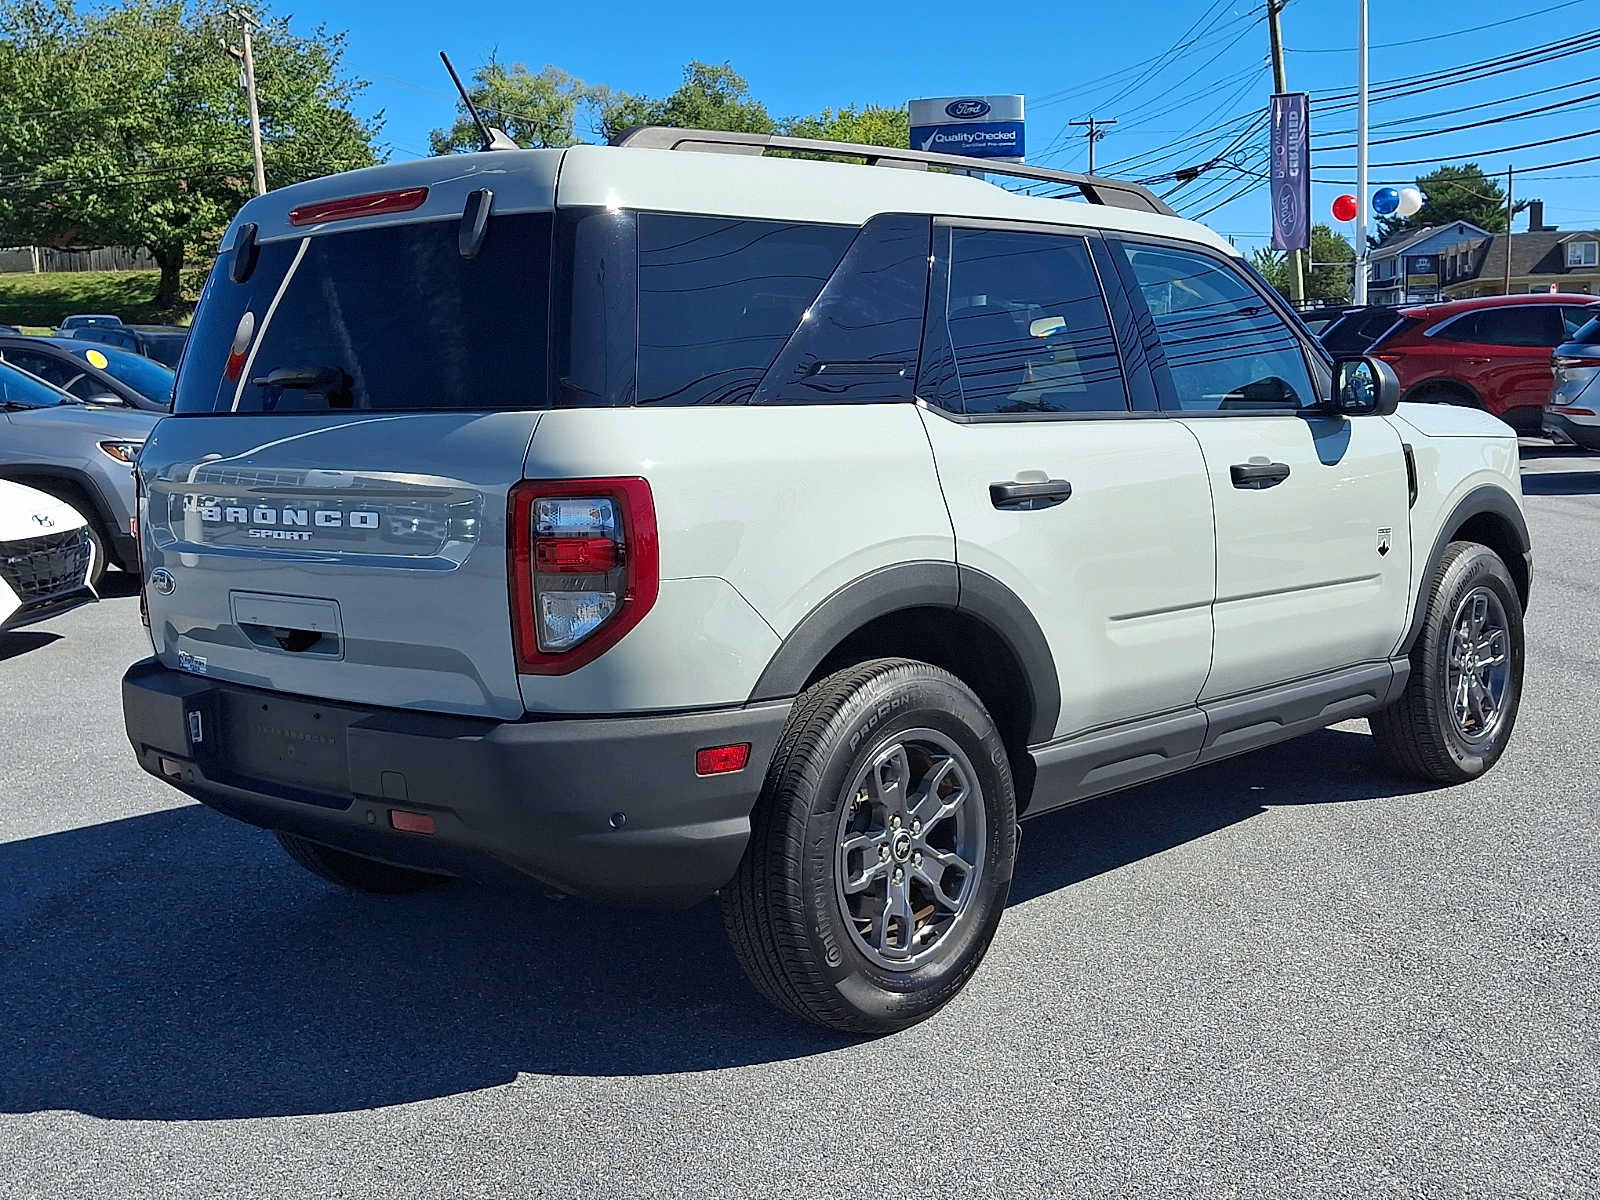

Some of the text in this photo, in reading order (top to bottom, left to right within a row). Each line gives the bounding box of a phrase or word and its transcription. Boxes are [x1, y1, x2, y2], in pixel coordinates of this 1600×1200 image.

[955, 102, 981, 115] Ford
[935, 131, 1016, 143] QualityChecked
[202, 507, 379, 529] BRONCO
[248, 528, 313, 541] SPORT
